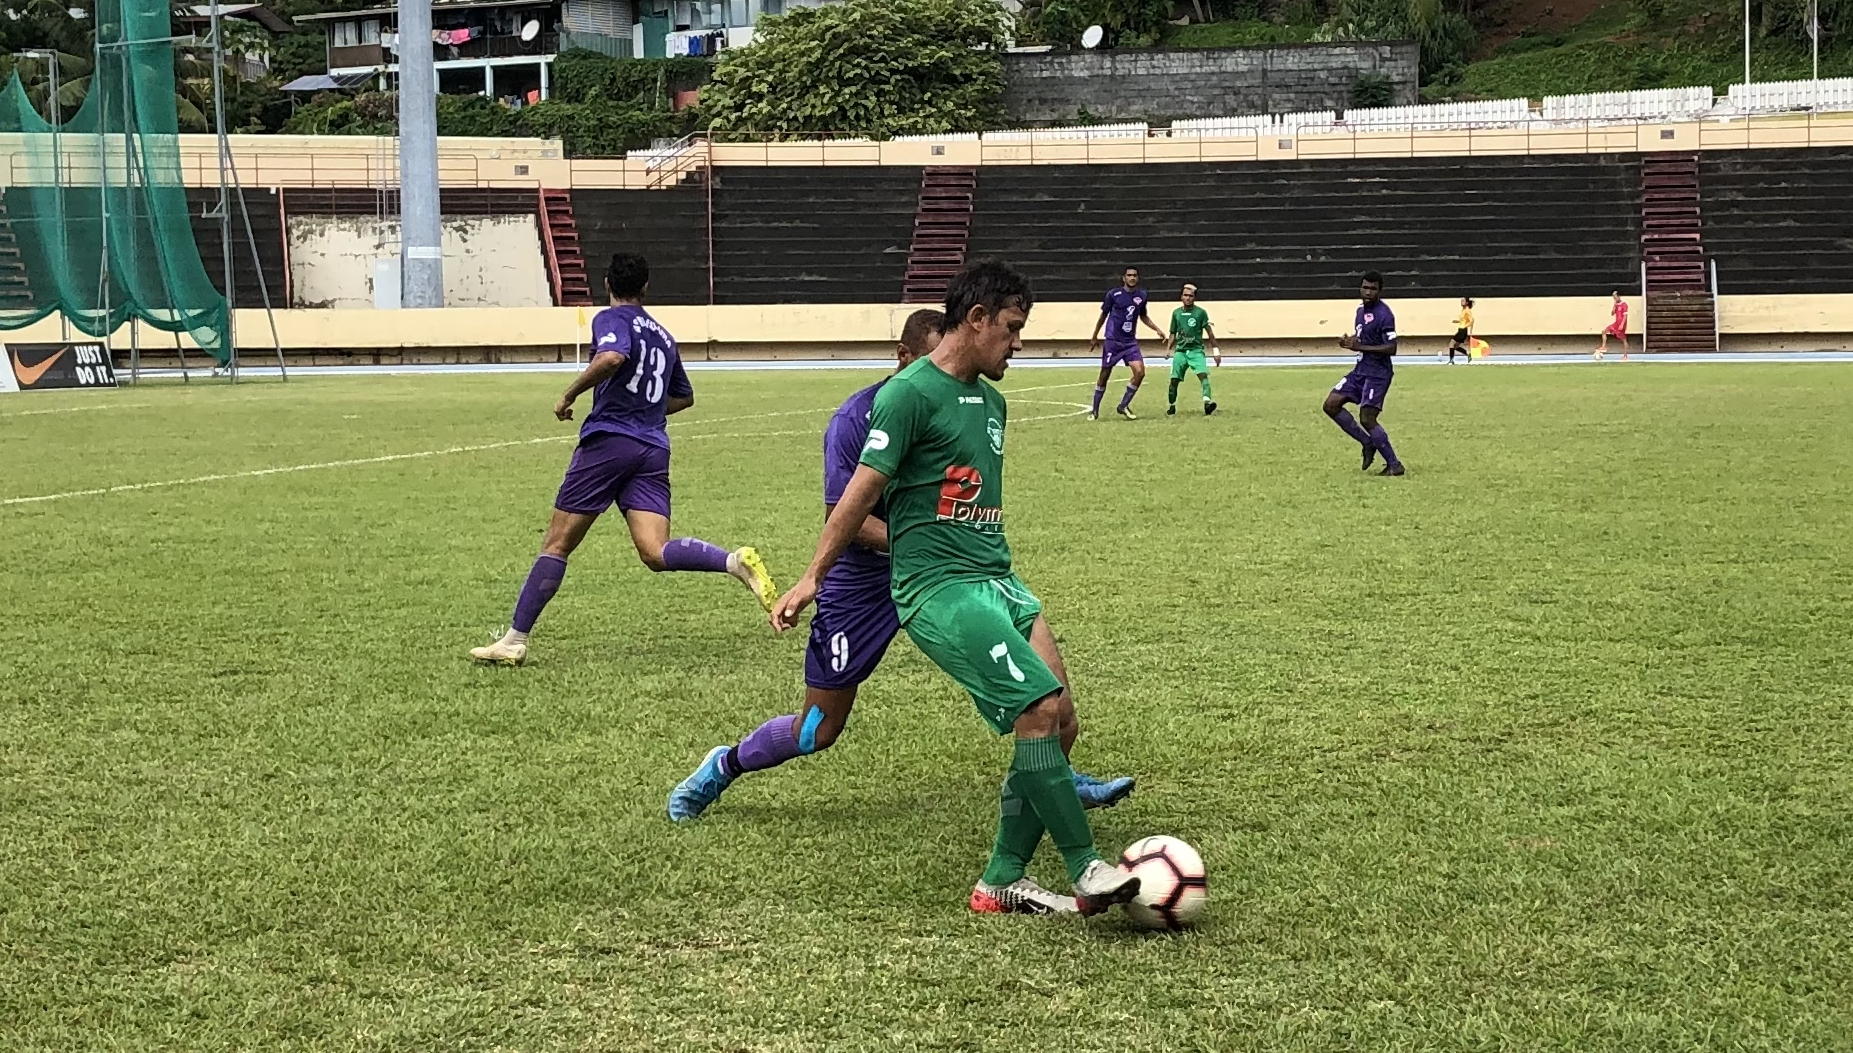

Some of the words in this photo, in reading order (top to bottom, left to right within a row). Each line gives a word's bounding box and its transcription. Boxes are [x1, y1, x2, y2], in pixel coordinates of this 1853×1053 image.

[74, 345, 102, 364] JUST
[75, 366, 95, 385] DO
[95, 365, 114, 384] IT.
[626, 339, 666, 403] 13
[831, 631, 849, 672] 9
[989, 641, 1026, 682] 7
